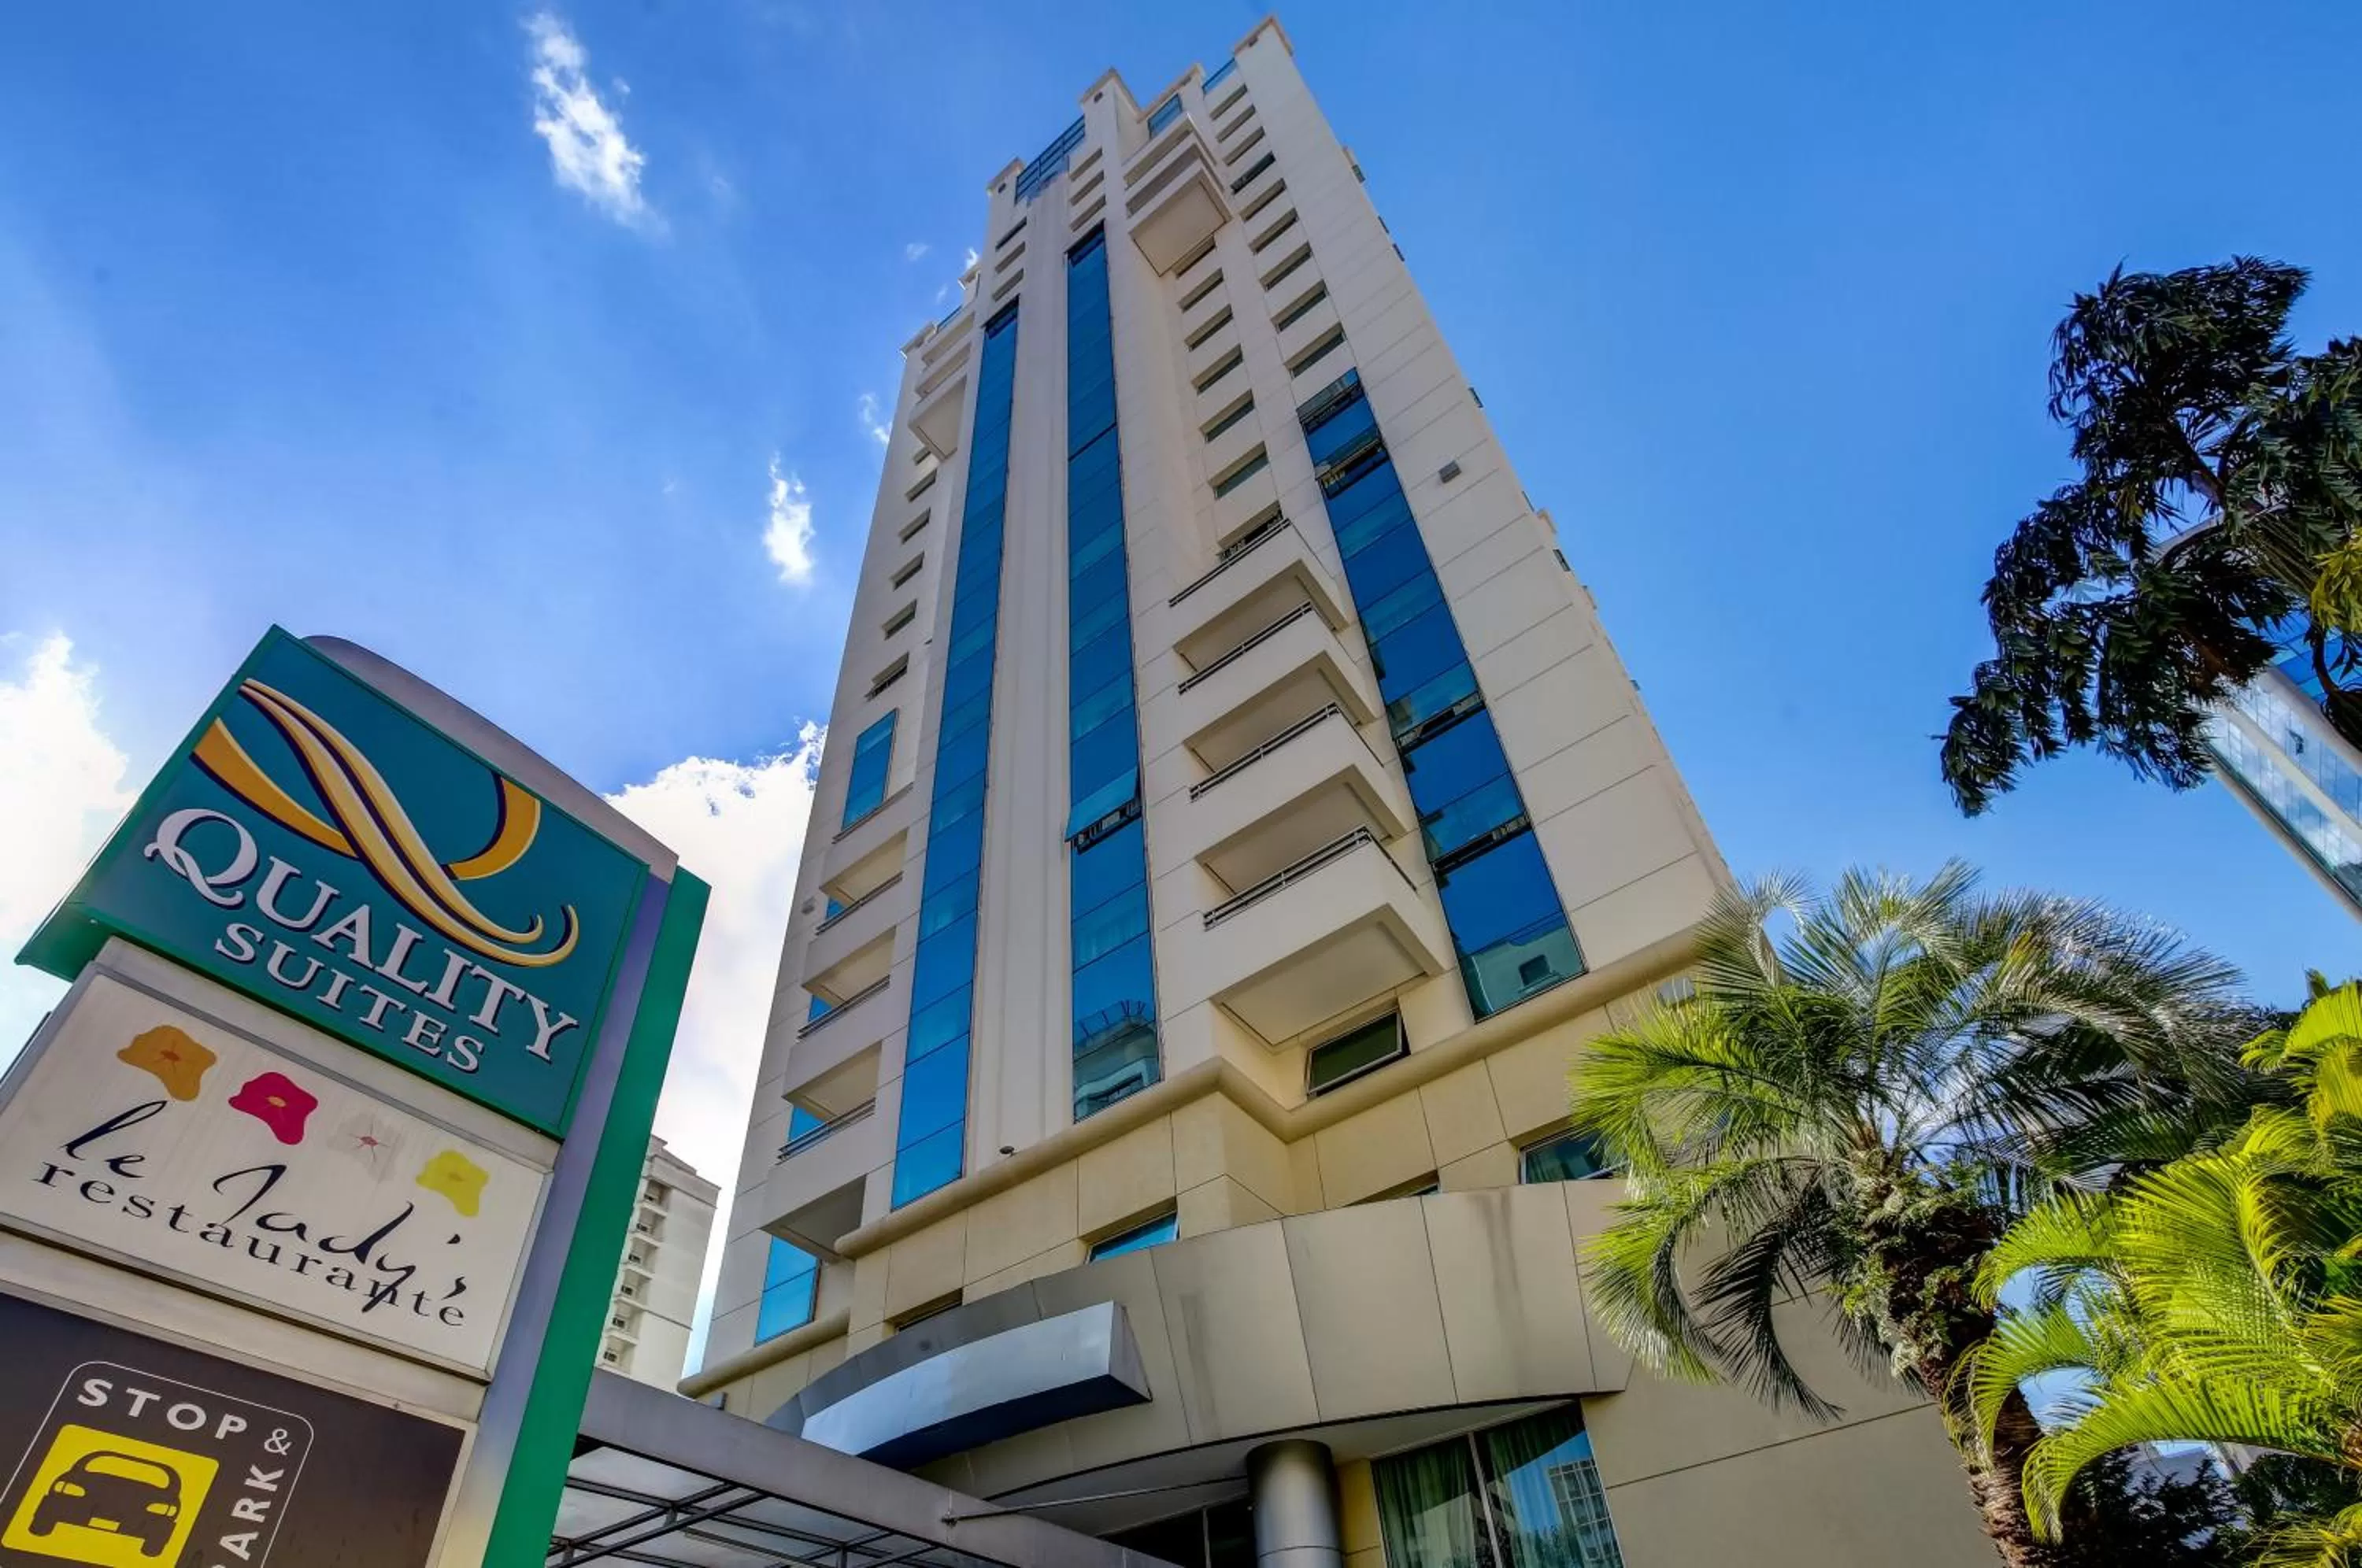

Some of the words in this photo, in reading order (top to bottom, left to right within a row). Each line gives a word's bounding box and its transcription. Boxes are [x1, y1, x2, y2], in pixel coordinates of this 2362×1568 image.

[144, 808, 579, 1063] QUALITY
[215, 923, 486, 1074] SUITES
[33, 1160, 465, 1327] restaurante
[77, 1378, 248, 1440] STOP
[264, 1429, 293, 1455] &
[211, 1464, 284, 1568] ARK
